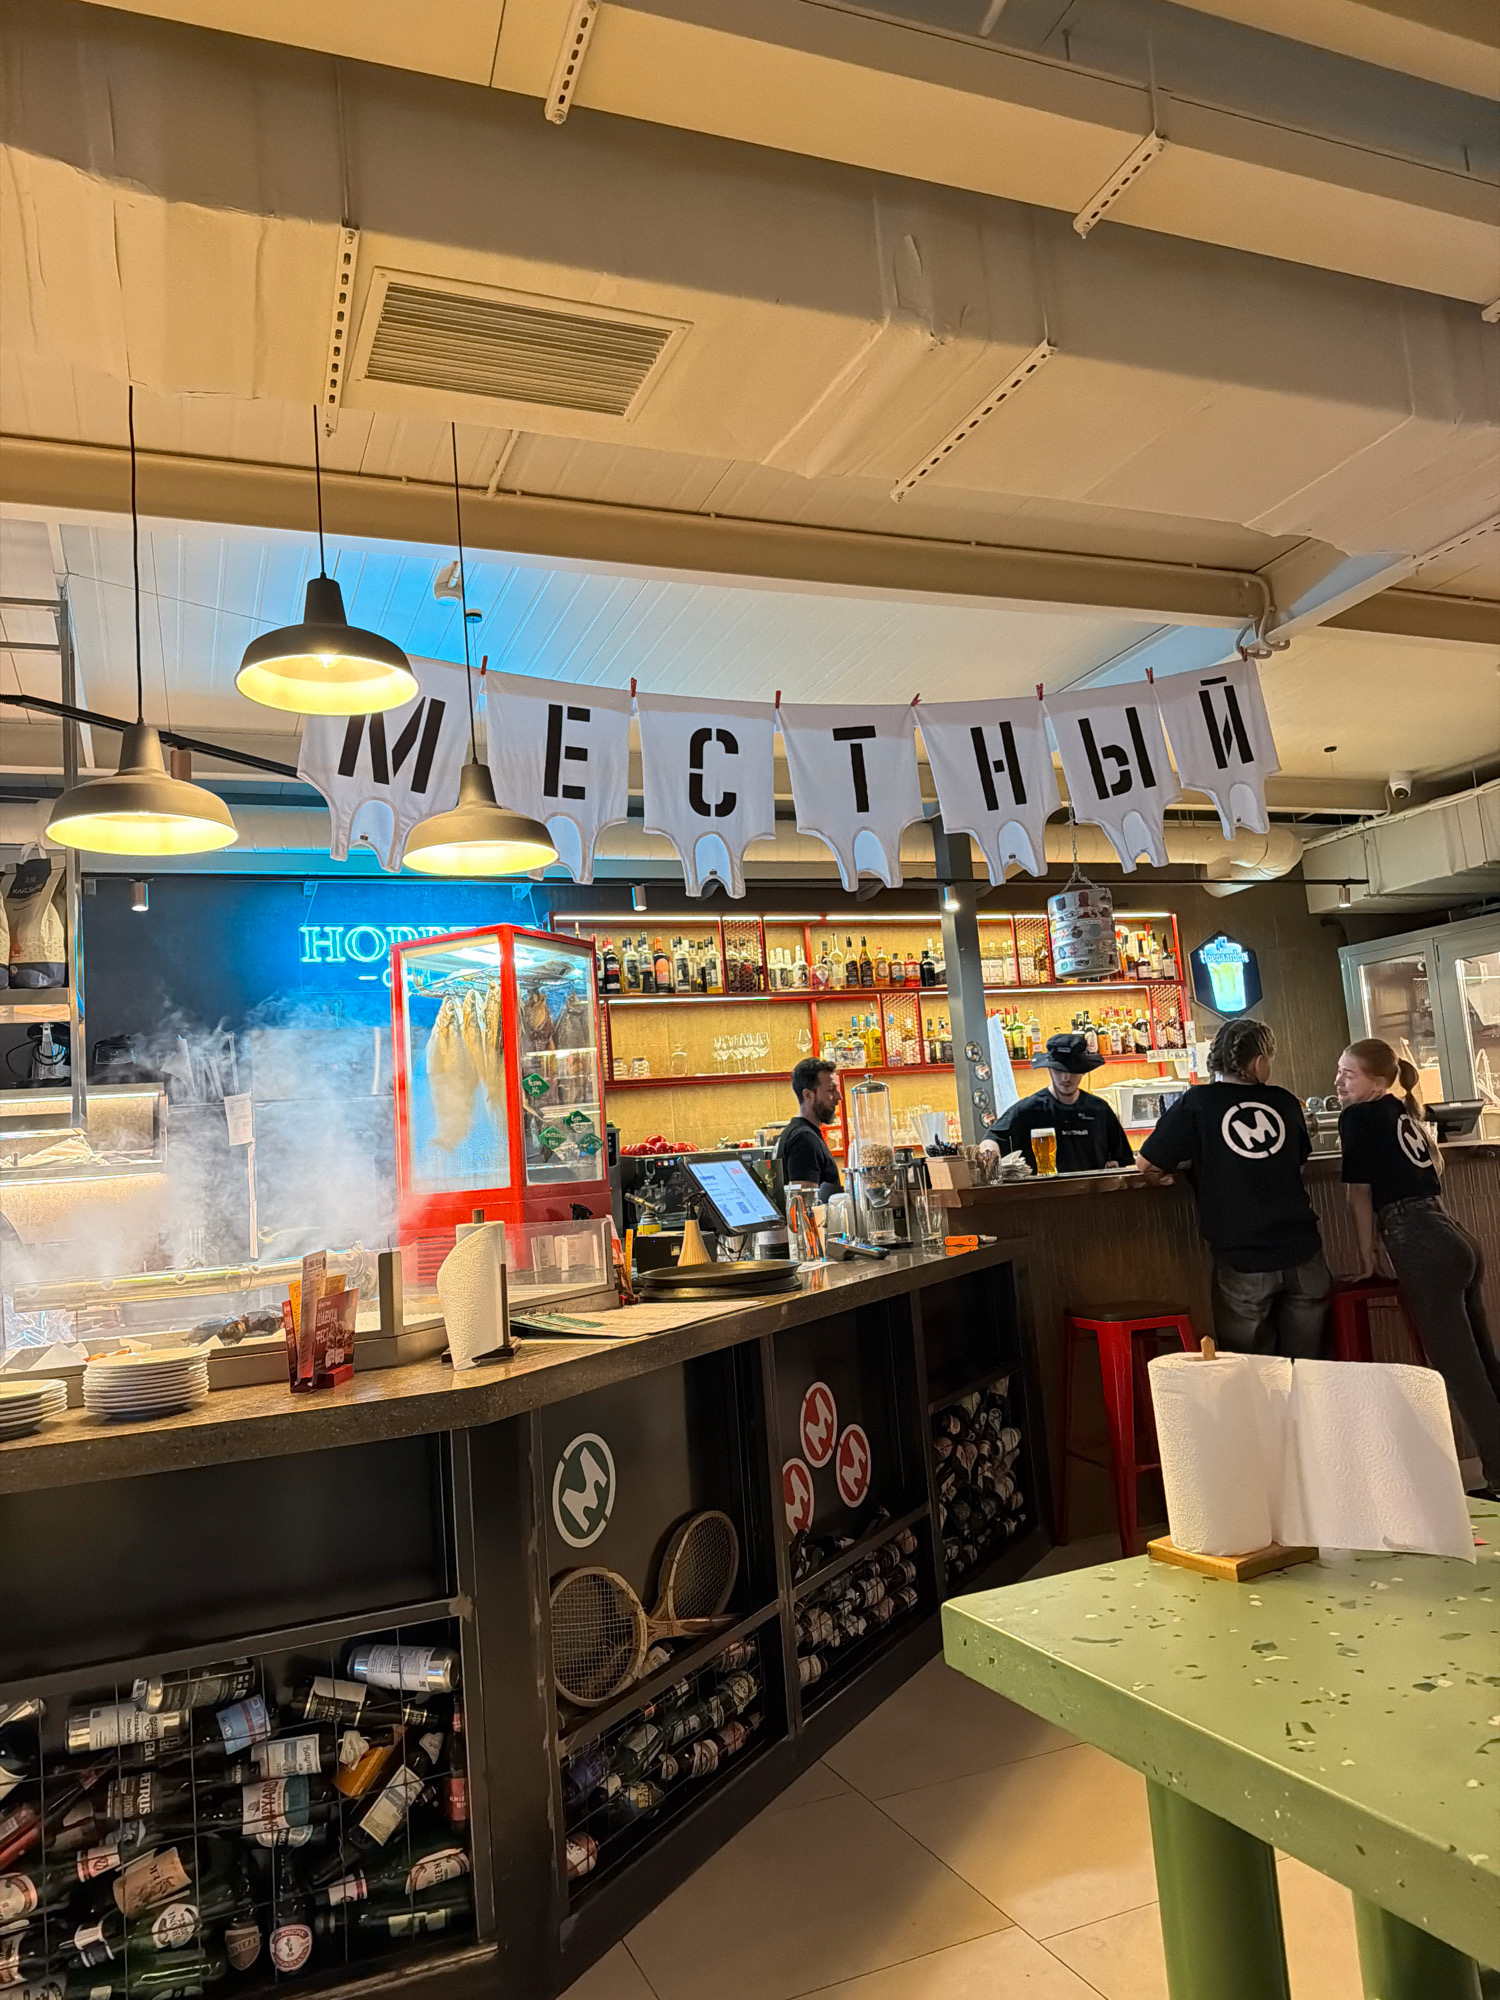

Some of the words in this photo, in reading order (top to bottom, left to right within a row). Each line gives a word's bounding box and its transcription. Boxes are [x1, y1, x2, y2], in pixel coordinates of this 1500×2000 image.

[337, 676, 1255, 817] МЕСТНЫЙ
[1199, 949, 1250, 965] Hoegaarden
[260, 1780, 279, 1831] SHIPYARD
